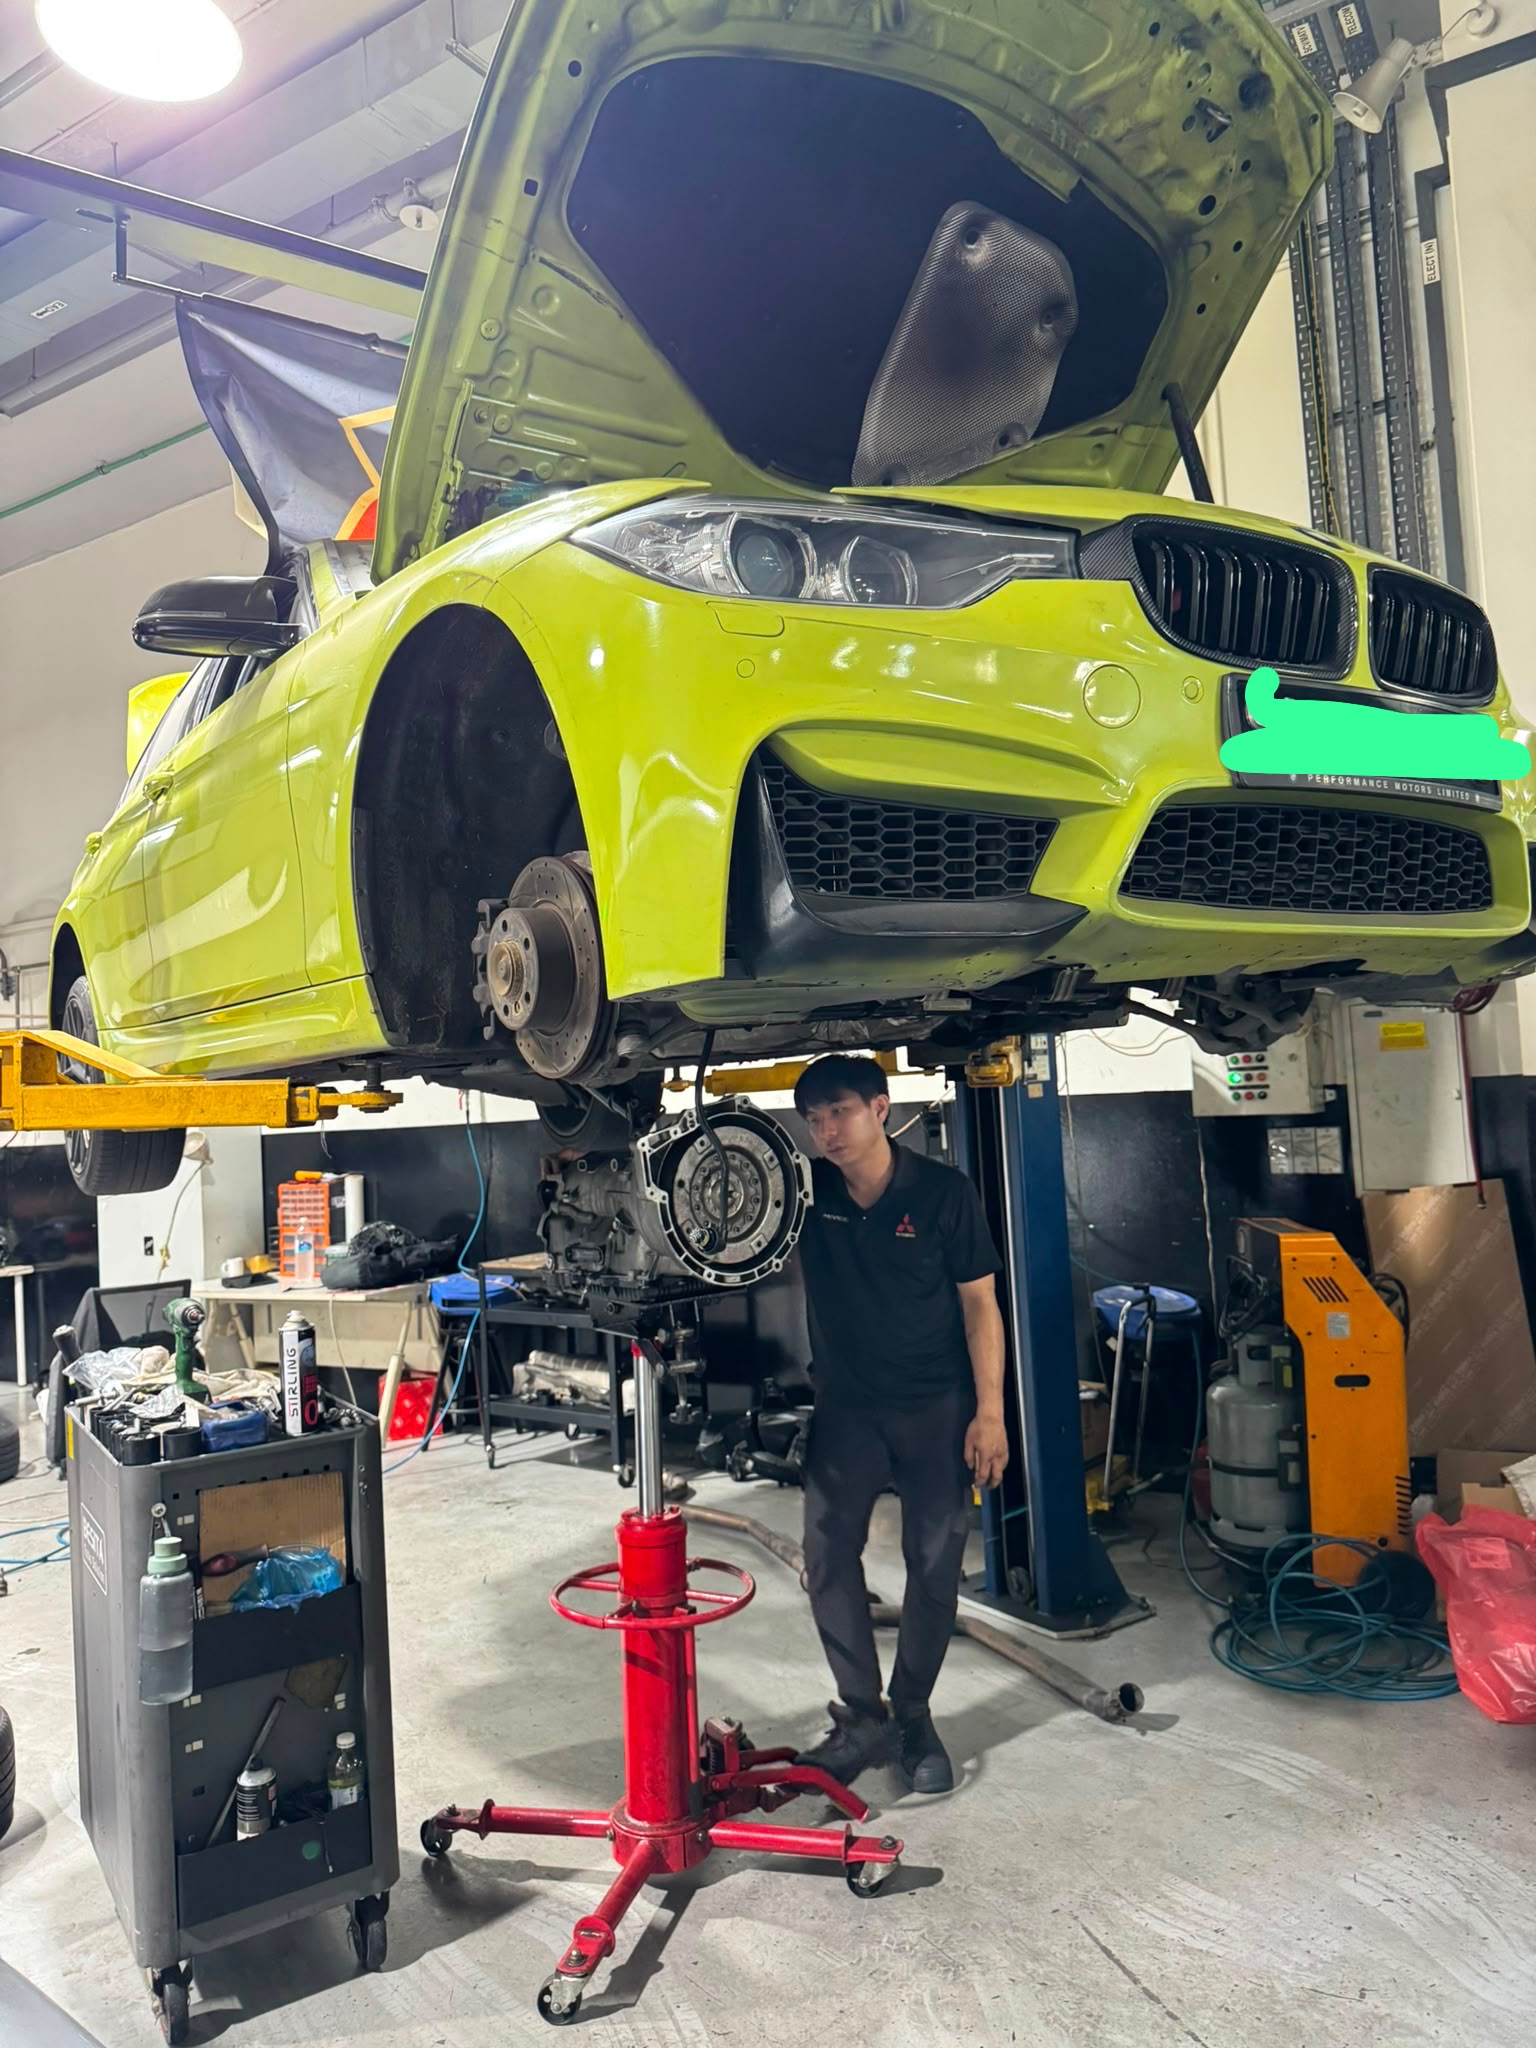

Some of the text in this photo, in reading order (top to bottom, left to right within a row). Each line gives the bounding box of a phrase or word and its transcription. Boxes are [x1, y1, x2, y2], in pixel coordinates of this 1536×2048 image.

[1341, 6, 1358, 36] TELECOM
[1423, 241, 1437, 282] ELECT (N)
[1307, 774, 1470, 801] PERFORMANCE MOTORS LIMITED
[287, 1347, 299, 1417] STIRLING
